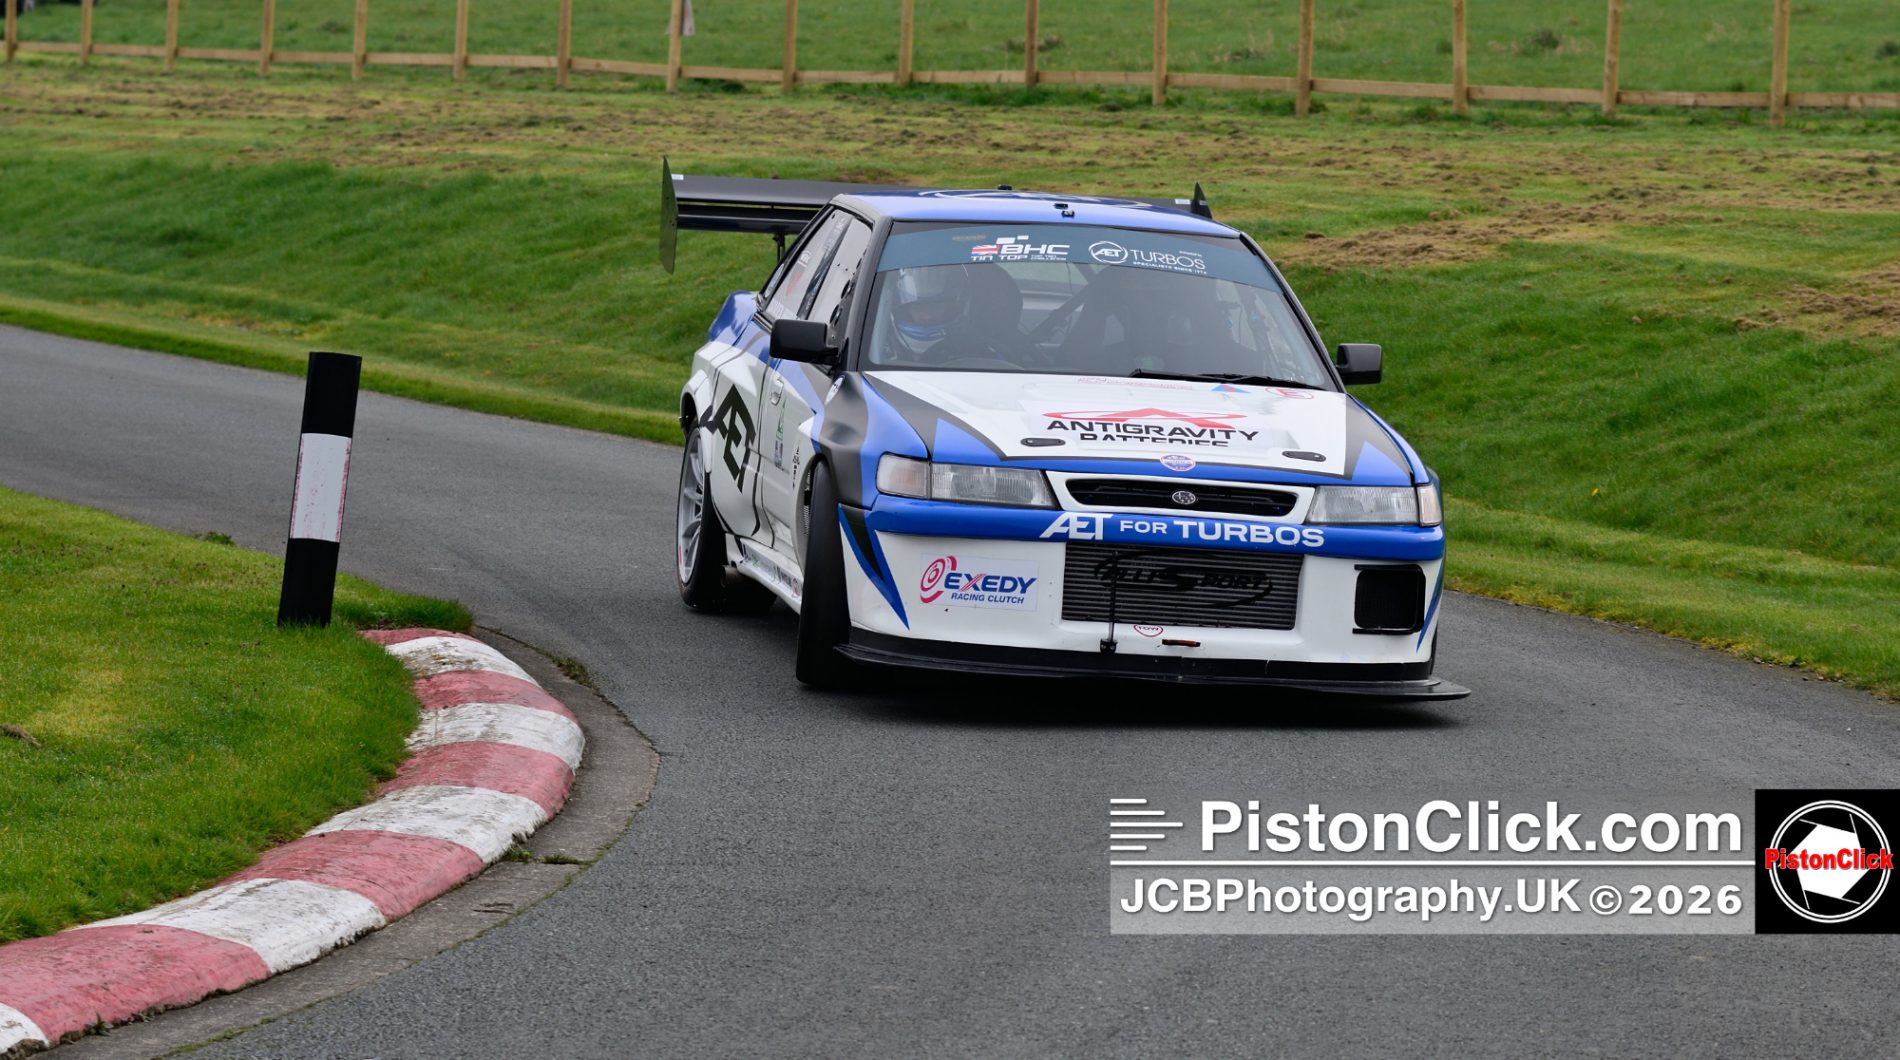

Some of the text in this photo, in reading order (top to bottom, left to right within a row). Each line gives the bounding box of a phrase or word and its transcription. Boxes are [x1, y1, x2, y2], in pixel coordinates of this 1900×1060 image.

[1000, 244, 1070, 255] BHC
[1130, 249, 1206, 270] TURBOS
[1047, 420, 1259, 441] ANTIGRAVITY
[1120, 520, 1168, 534] FOR
[1173, 519, 1325, 547] TURBOS
[944, 572, 1038, 594] EXEDY
[951, 592, 1025, 604] RACING CLUTCH
